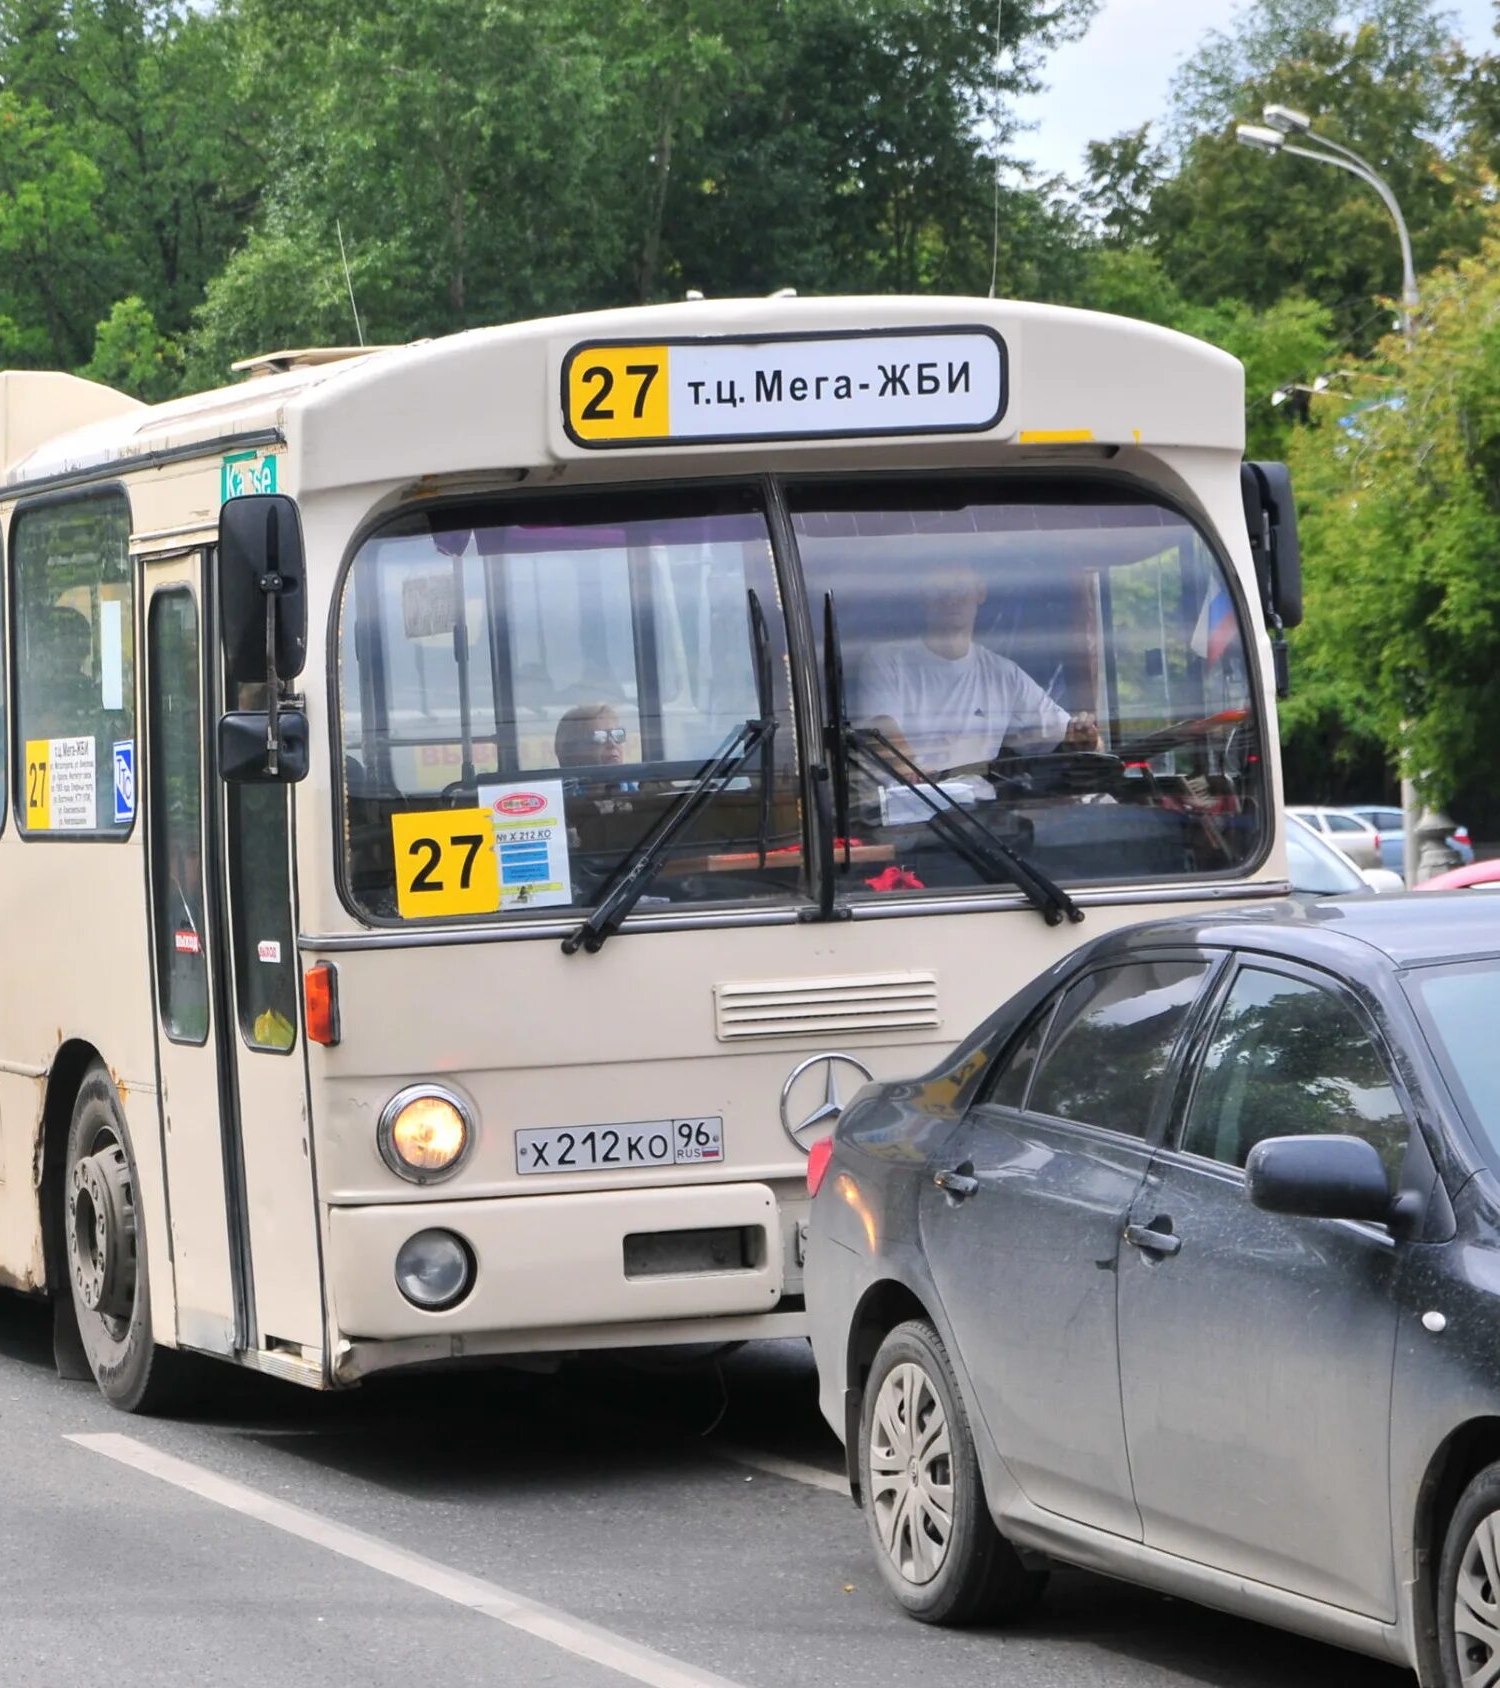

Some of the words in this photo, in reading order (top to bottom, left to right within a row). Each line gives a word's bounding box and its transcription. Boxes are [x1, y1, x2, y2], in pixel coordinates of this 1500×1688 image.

[581, 365, 660, 420] 27
[226, 463, 272, 498] Kase
[29, 762, 46, 808] 27
[519, 831, 535, 840] 212
[538, 829, 552, 839] КО
[409, 834, 484, 893] 27
[678, 1122, 710, 1147] 96
[677, 1149, 701, 1159] RUS
